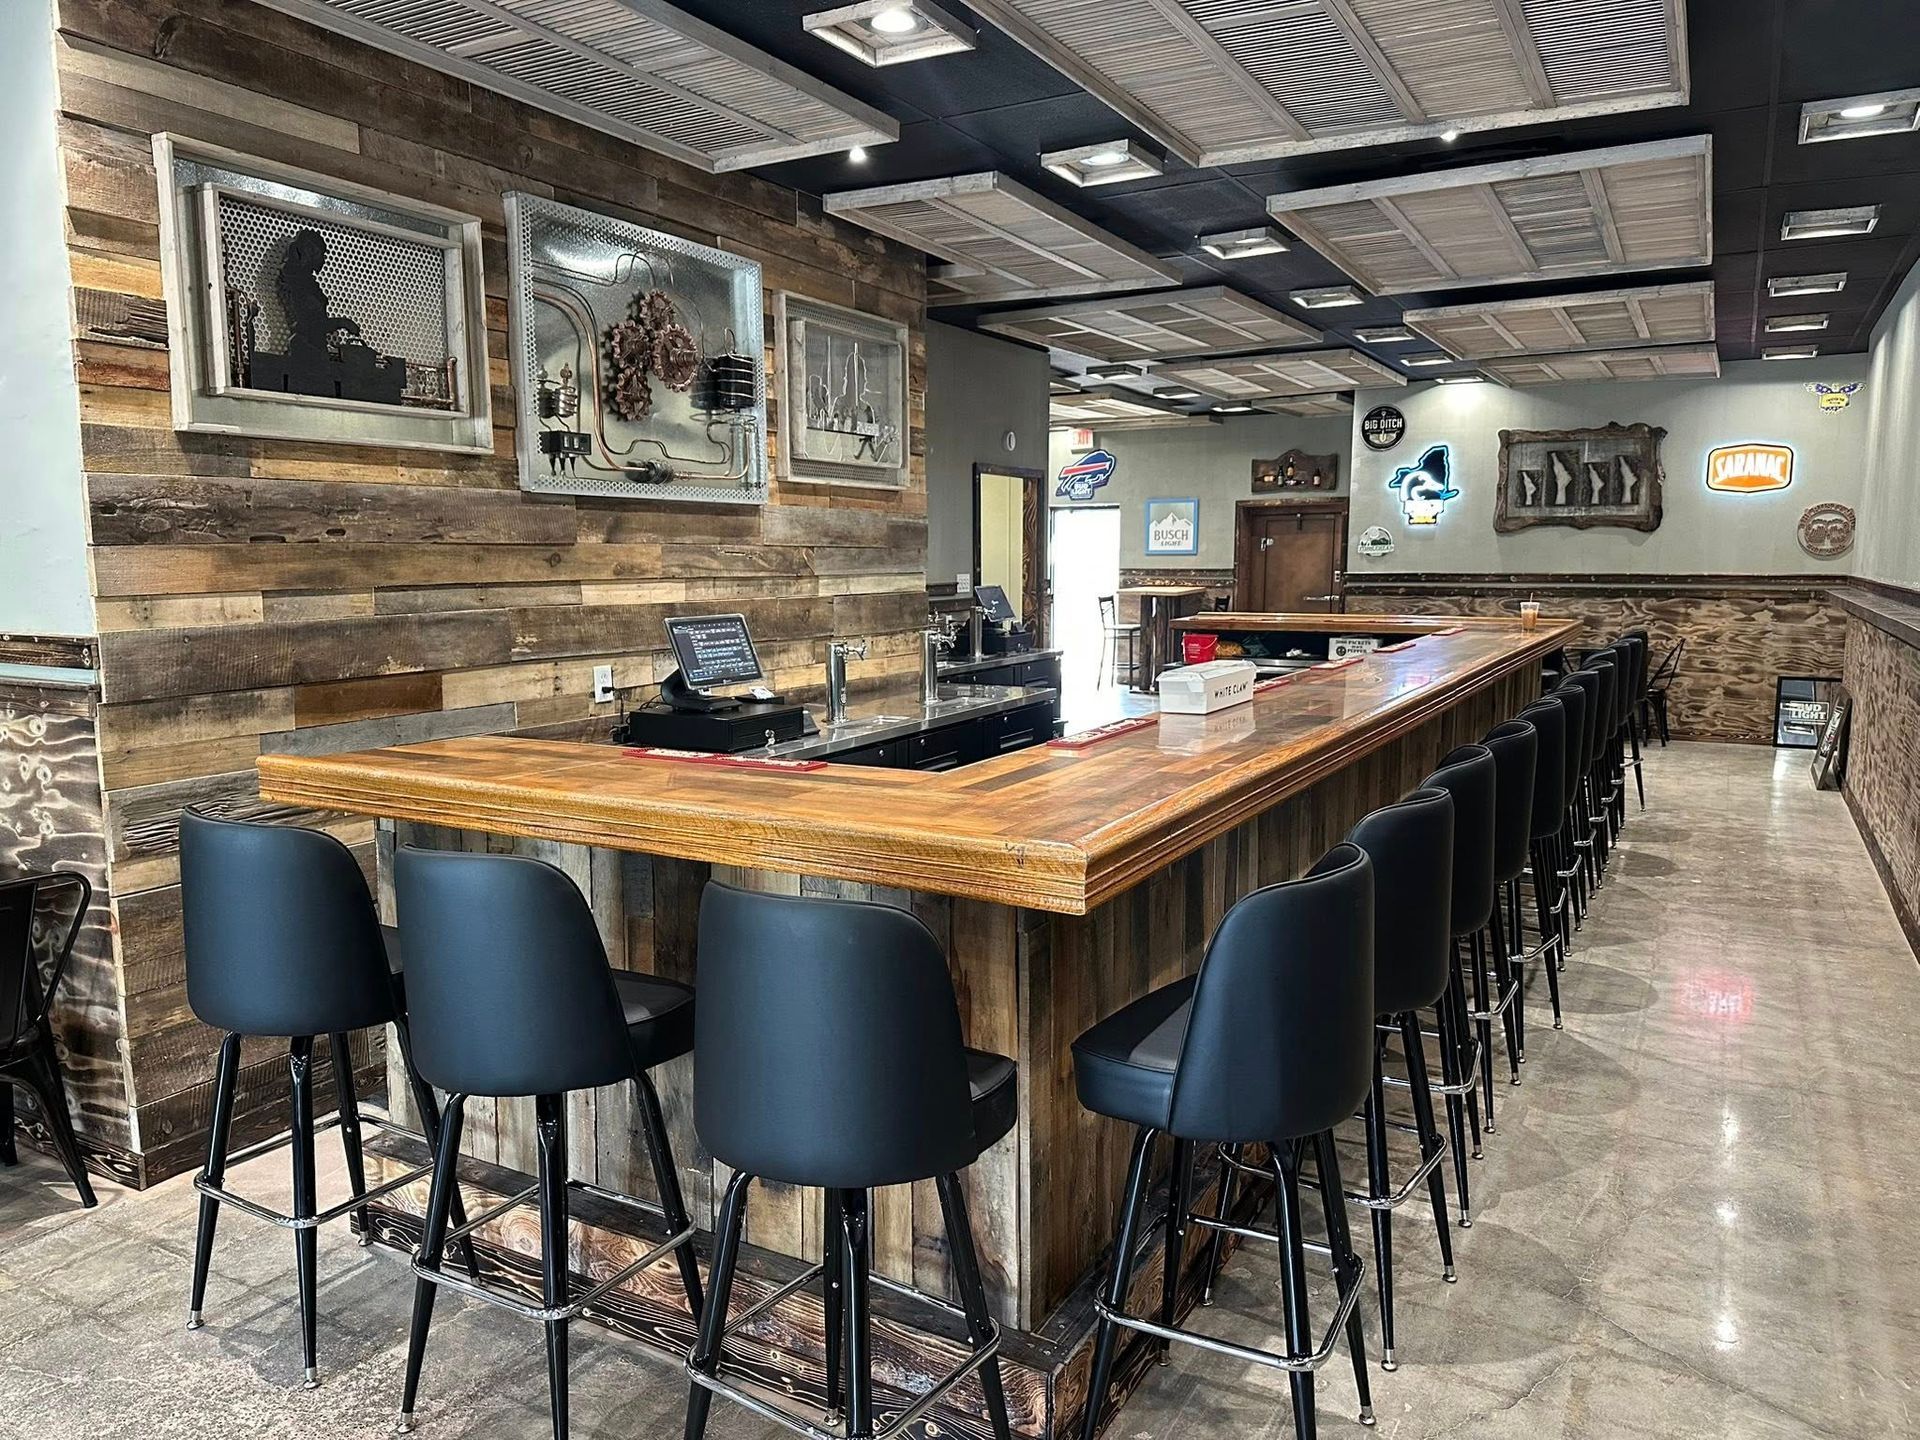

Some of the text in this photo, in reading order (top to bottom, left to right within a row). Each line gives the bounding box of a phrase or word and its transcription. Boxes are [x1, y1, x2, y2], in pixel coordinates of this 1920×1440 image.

[1364, 418, 1403, 430] BIG DITCH
[1714, 452, 1787, 482] SARANAC
[1154, 529, 1189, 541] BUSCH
[1214, 681, 1248, 698] WHITE CLAW
[1791, 710, 1826, 719] LIGHT
